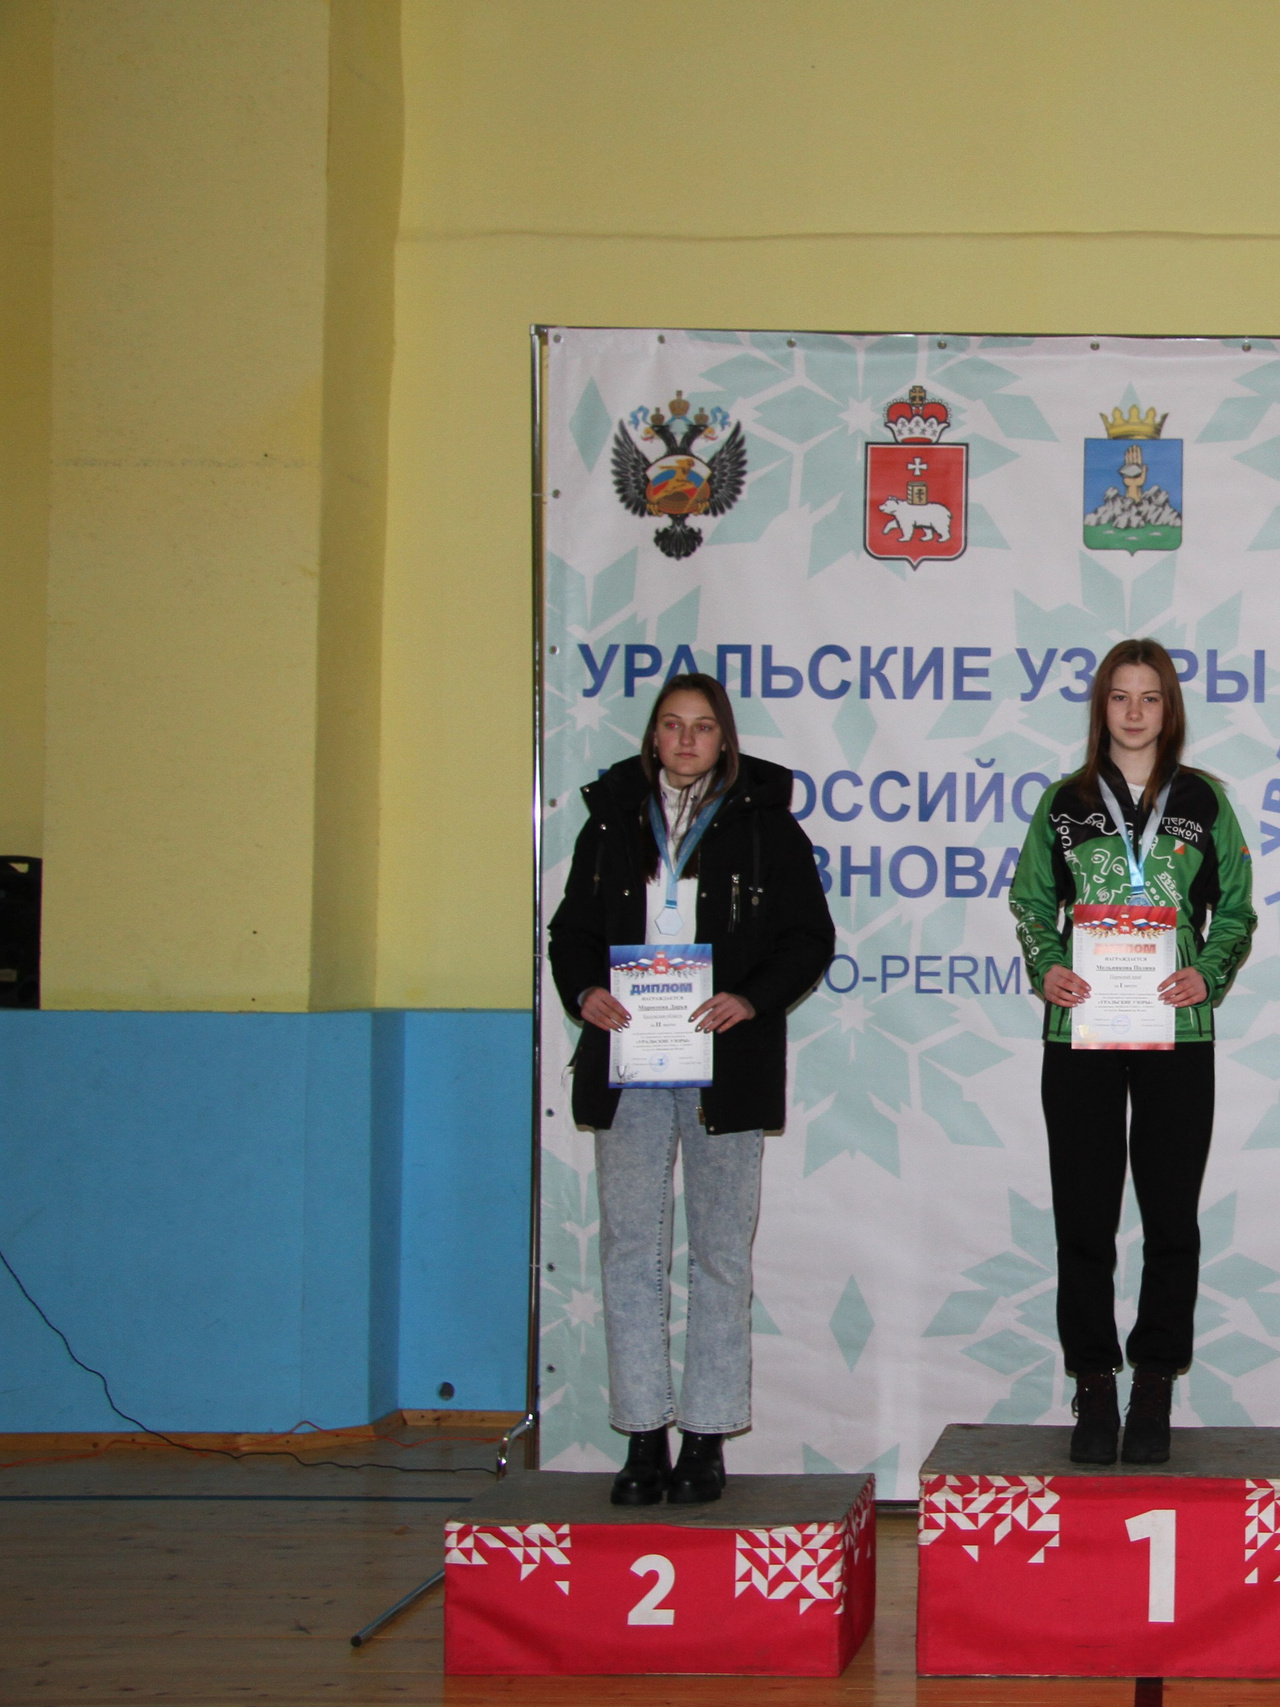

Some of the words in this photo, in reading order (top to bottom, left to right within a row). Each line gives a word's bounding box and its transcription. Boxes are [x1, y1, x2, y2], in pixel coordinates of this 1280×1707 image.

[1015, 646, 1266, 704] УЗРЫ
[1162, 816, 1203, 833] ПЕРМЬ
[1165, 825, 1199, 843] СОКОЛ
[630, 982, 693, 995] ДИПЛОМ
[1125, 1508, 1176, 1624] 1
[627, 1553, 676, 1628] 2
